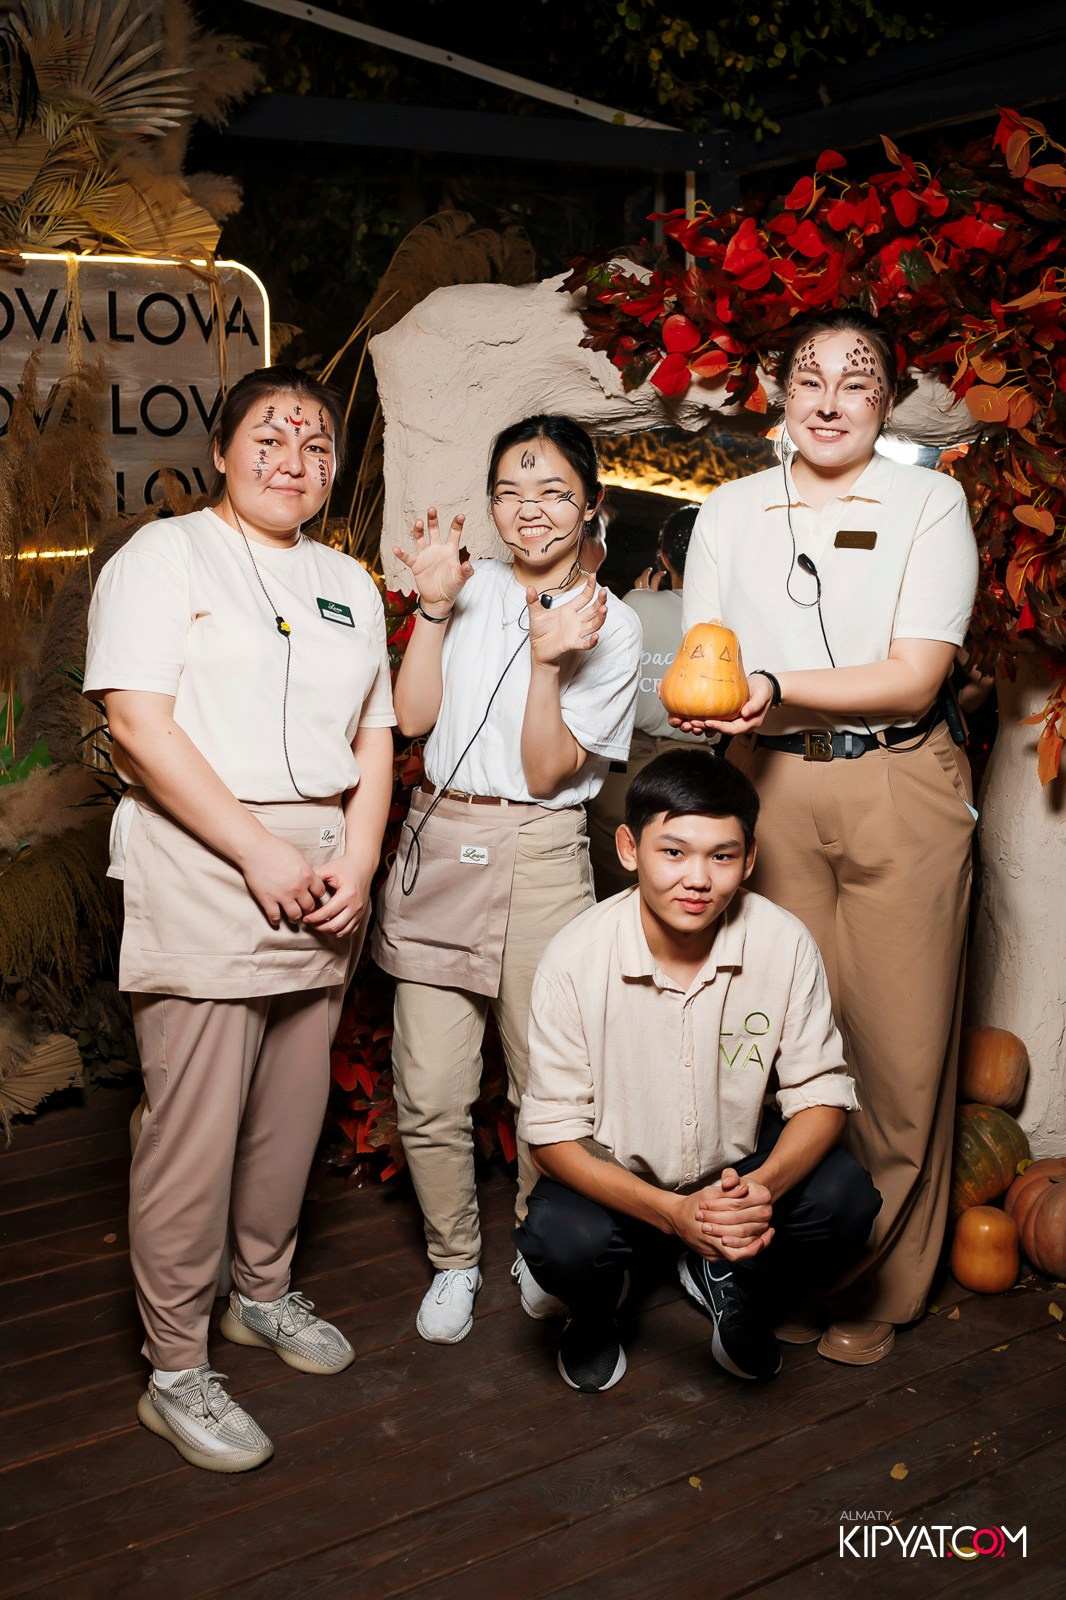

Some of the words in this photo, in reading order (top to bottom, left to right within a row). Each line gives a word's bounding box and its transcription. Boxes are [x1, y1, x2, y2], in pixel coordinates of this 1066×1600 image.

[108, 290, 259, 346] LOVA
[112, 384, 227, 437] LOV
[719, 1043, 767, 1073] VA
